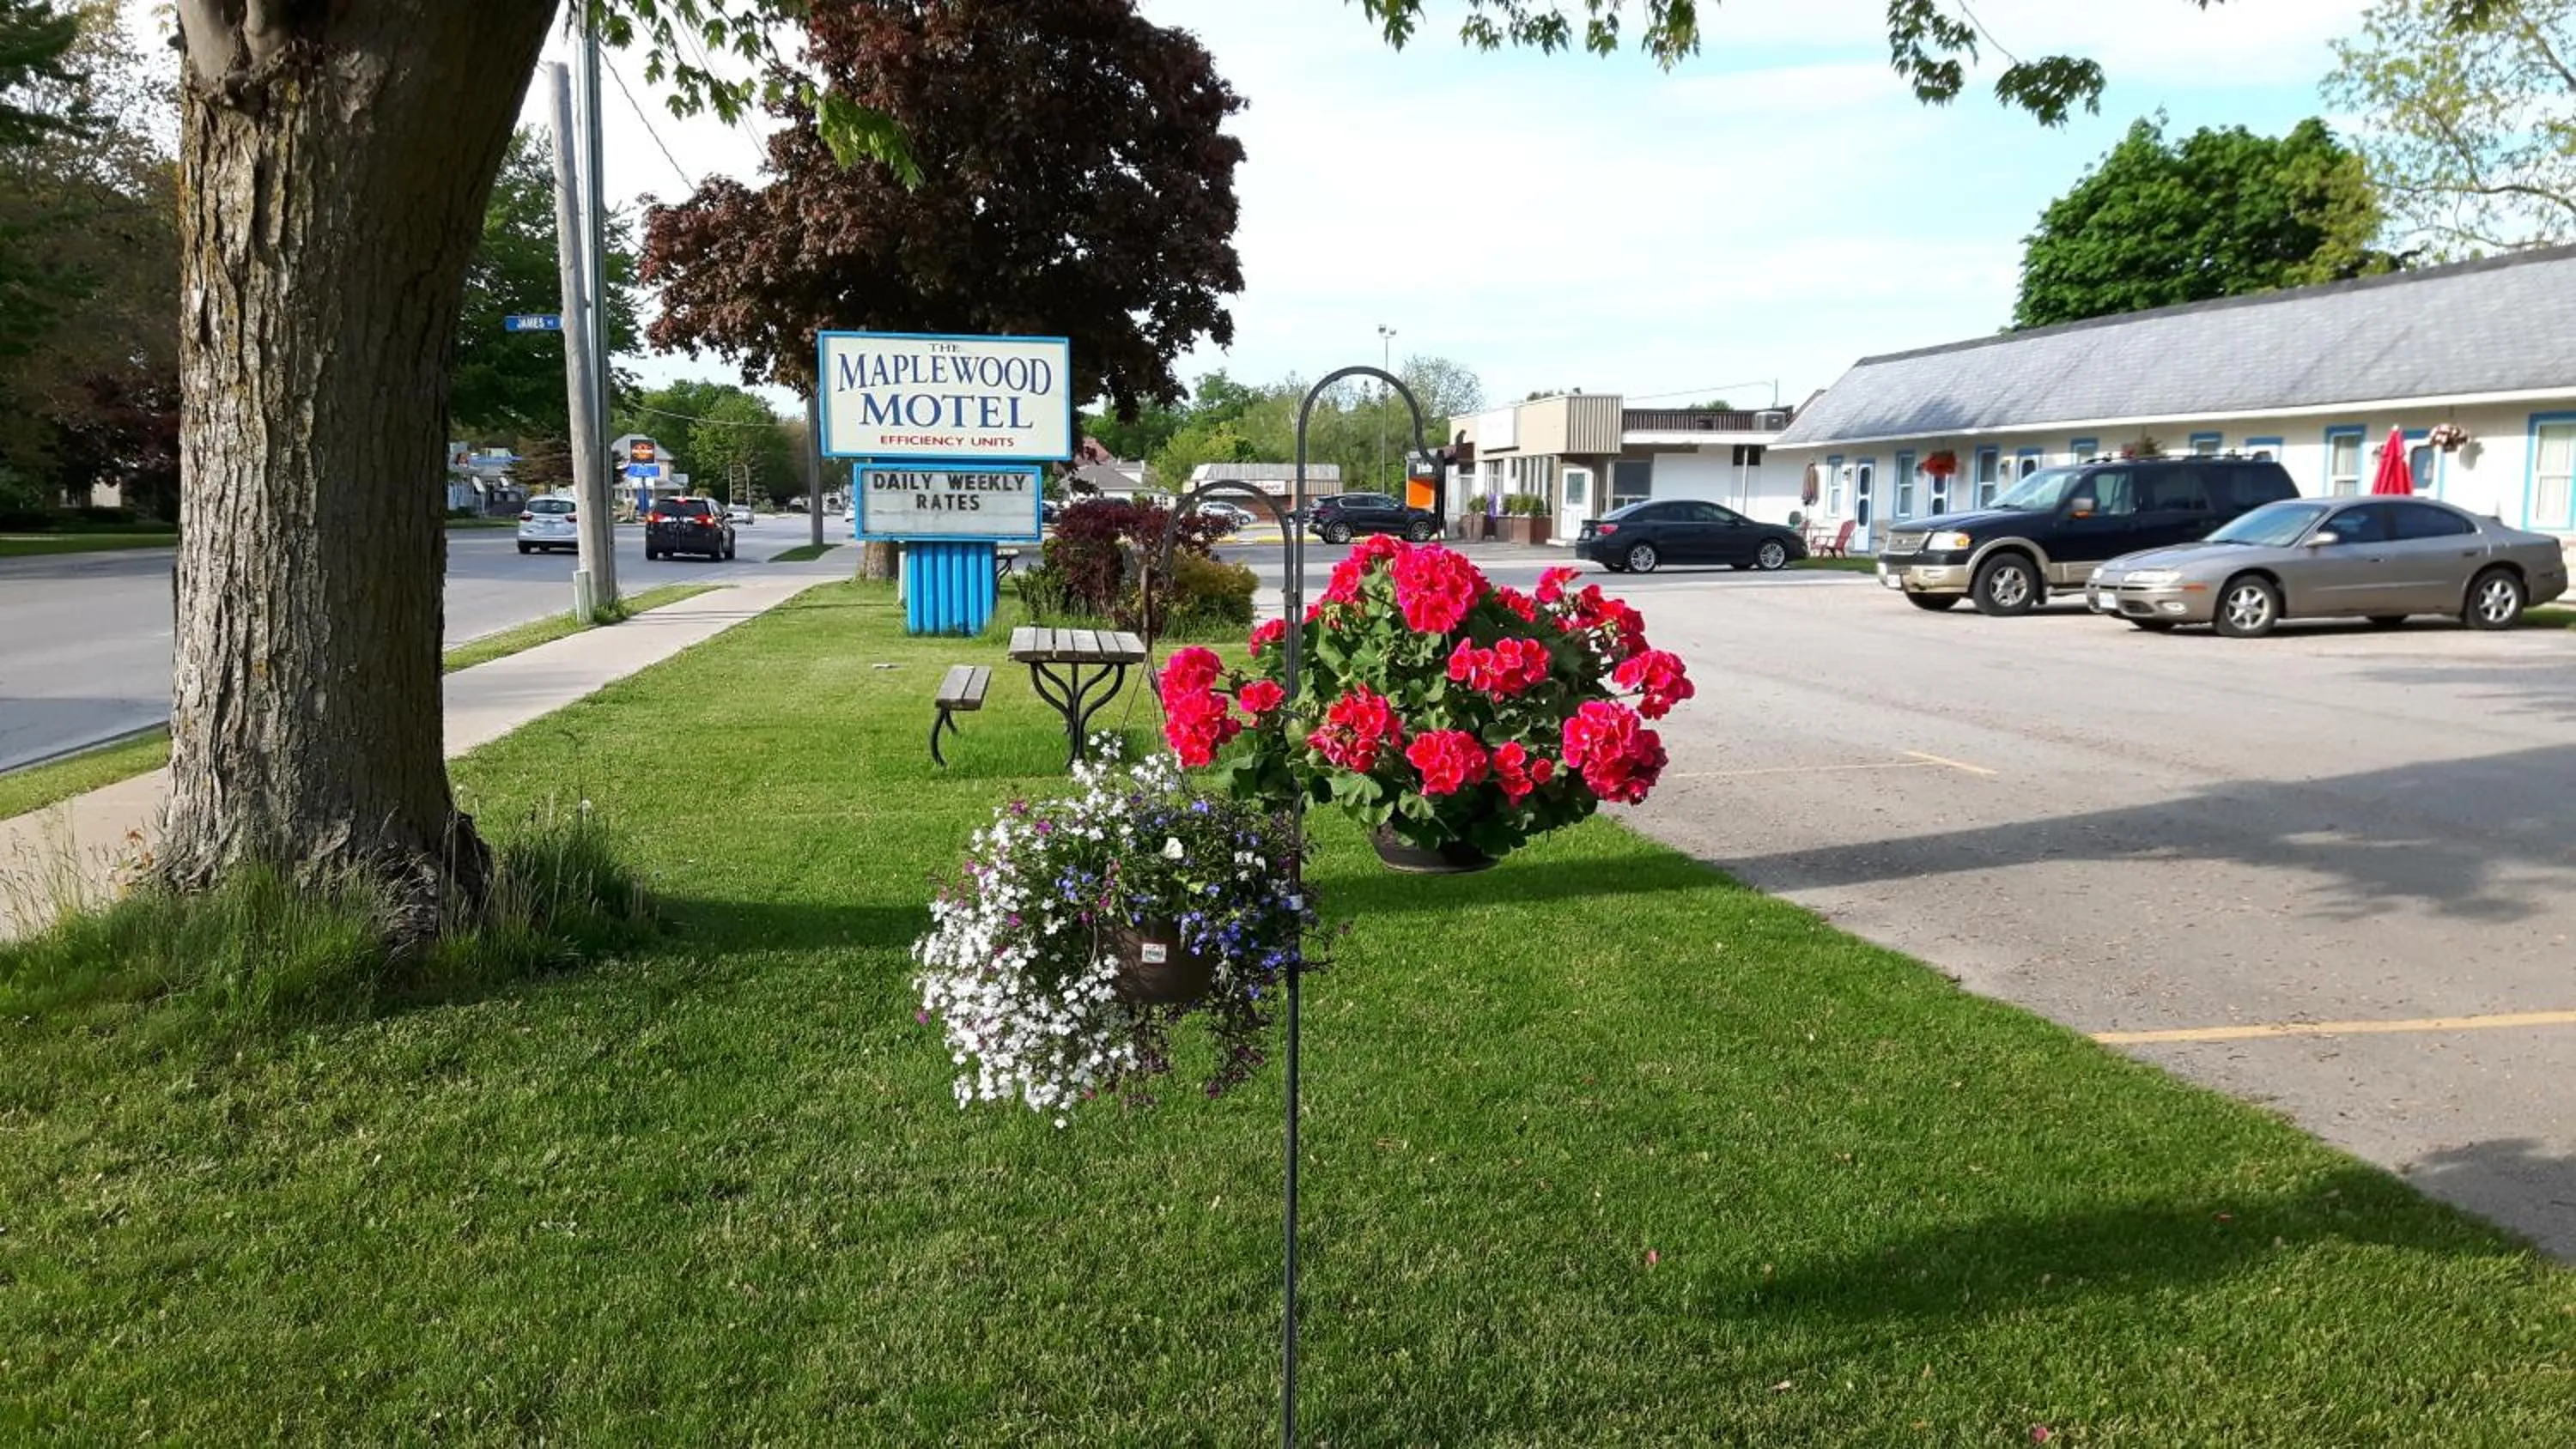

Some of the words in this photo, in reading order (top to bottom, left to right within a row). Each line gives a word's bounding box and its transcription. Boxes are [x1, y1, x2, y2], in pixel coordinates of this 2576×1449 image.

[517, 317, 545, 329] JAMES
[928, 343, 961, 353] THE
[837, 353, 1052, 396] MAPLEWOOD
[859, 392, 1034, 429] MOTEL
[880, 435, 964, 446] EFFICIENCY
[971, 438, 1015, 447] UNITS
[872, 473, 933, 490] DAILY
[947, 474, 1026, 491] WEEKLY
[916, 494, 981, 511] RATES
